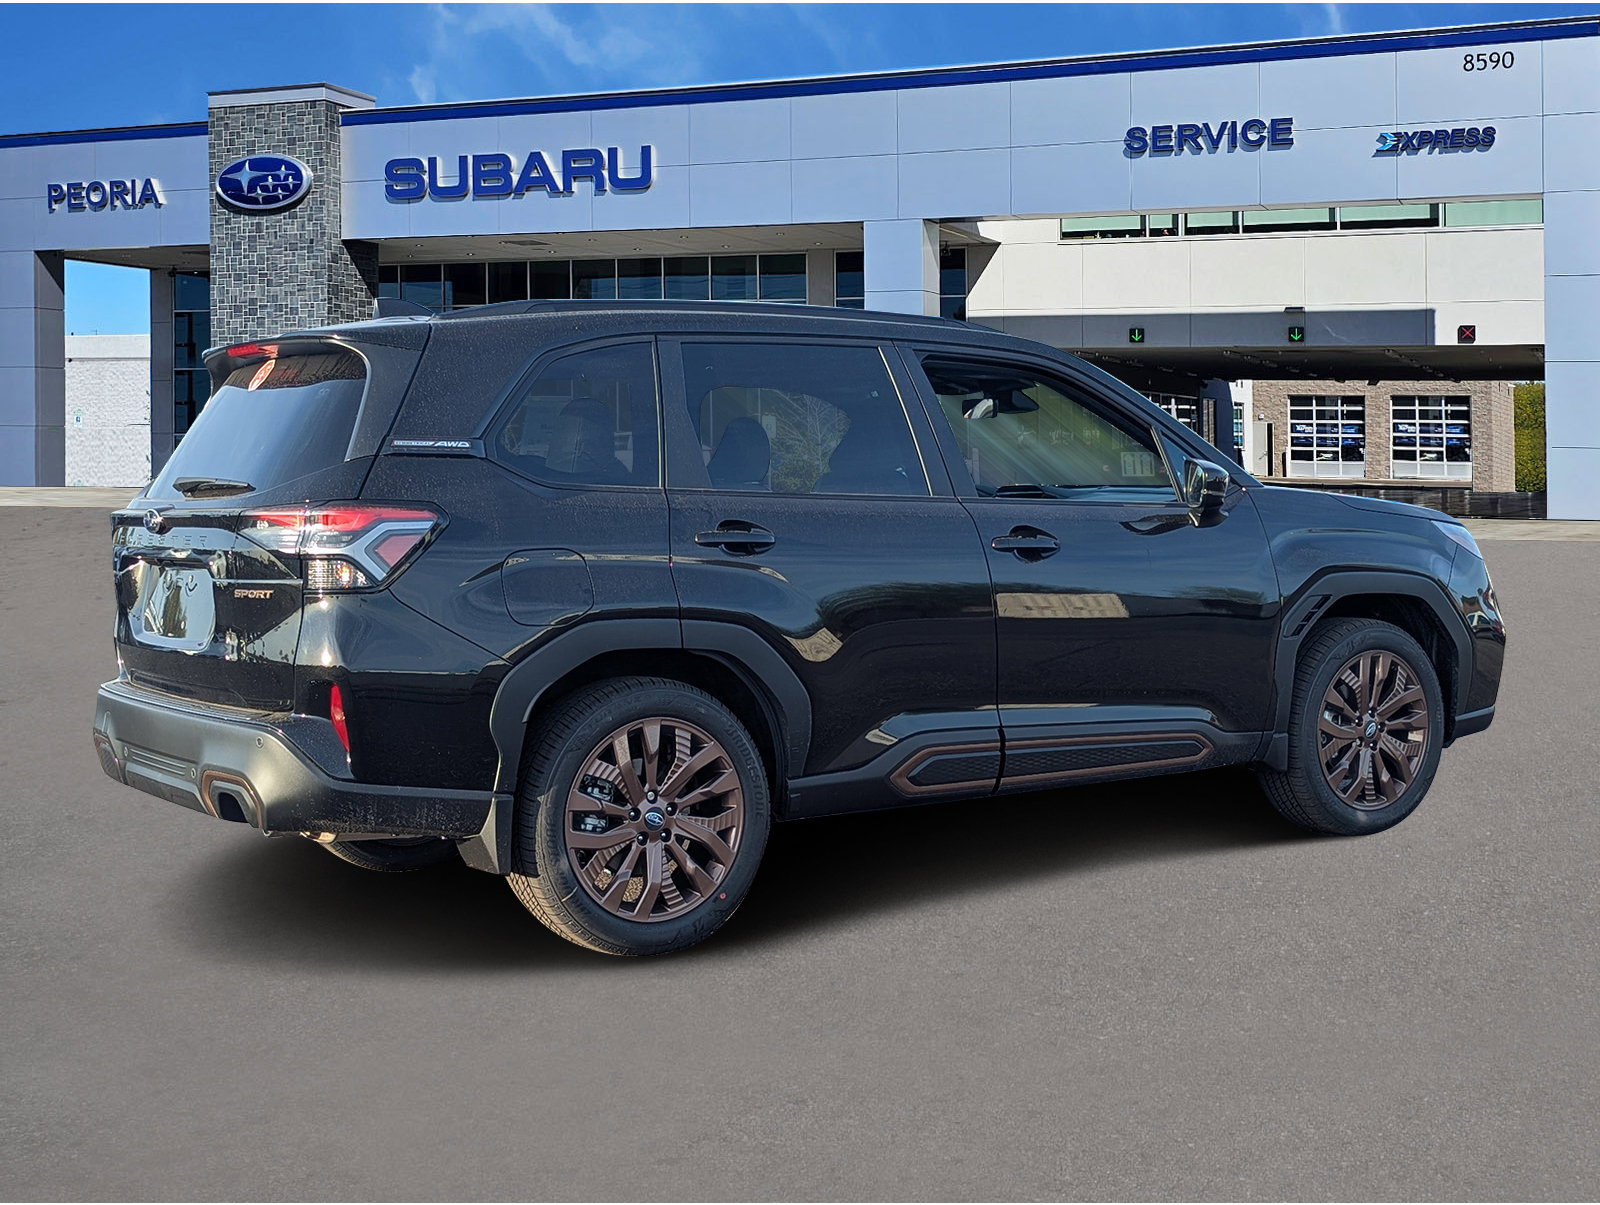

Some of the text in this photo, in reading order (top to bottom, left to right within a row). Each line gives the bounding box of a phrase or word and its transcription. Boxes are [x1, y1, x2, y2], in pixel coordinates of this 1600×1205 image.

[1463, 51, 1515, 72] 8590
[1124, 118, 1294, 154] SERVICE
[1374, 127, 1497, 153] EXPRESS
[385, 145, 655, 200] SUBARU
[48, 177, 163, 211] PEORIA
[434, 440, 470, 448] AWD
[234, 589, 274, 599] SPORT
